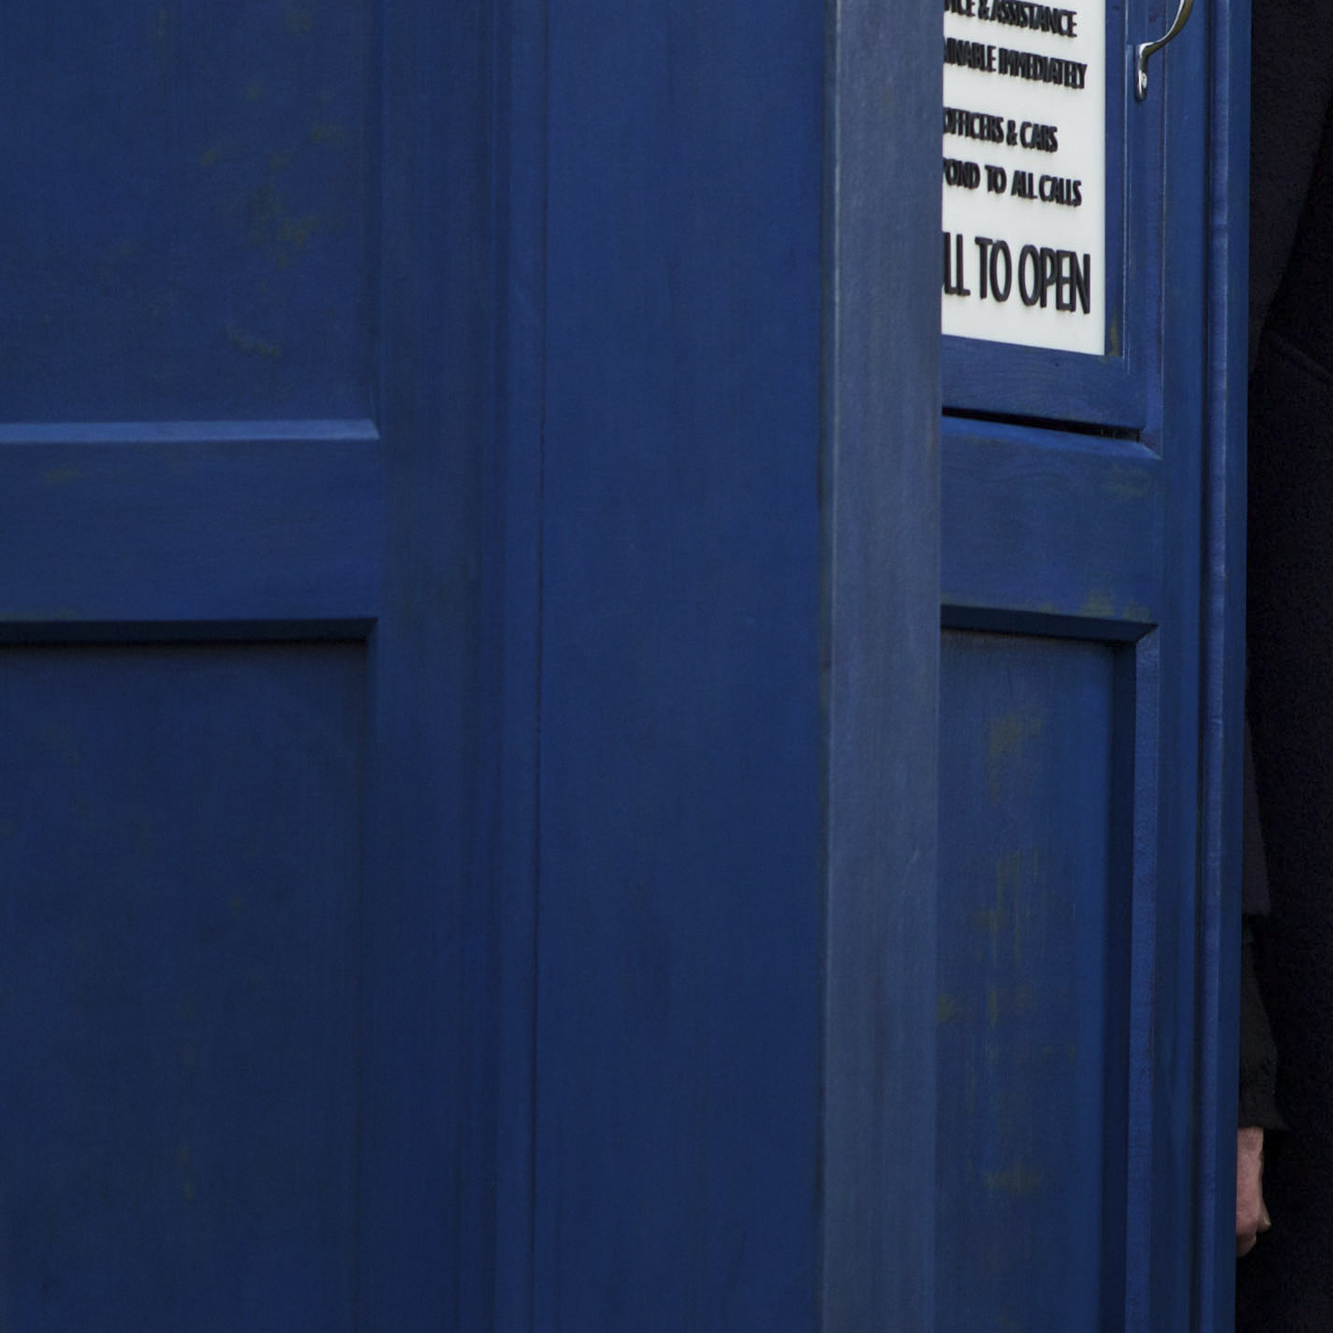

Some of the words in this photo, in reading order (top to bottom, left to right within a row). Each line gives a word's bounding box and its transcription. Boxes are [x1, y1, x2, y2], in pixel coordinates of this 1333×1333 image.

[998, 47, 1088, 89] IMMEDIATELY
[943, 107, 1004, 143] OFFICERS
[1006, 119, 1018, 146] &
[1020, 121, 1059, 153] CARS
[984, 164, 1008, 194] TO
[1011, 169, 1038, 200] ALL
[1039, 174, 1082, 207] CALLS
[974, 236, 1012, 302] TO
[1018, 244, 1091, 314] OPEN
